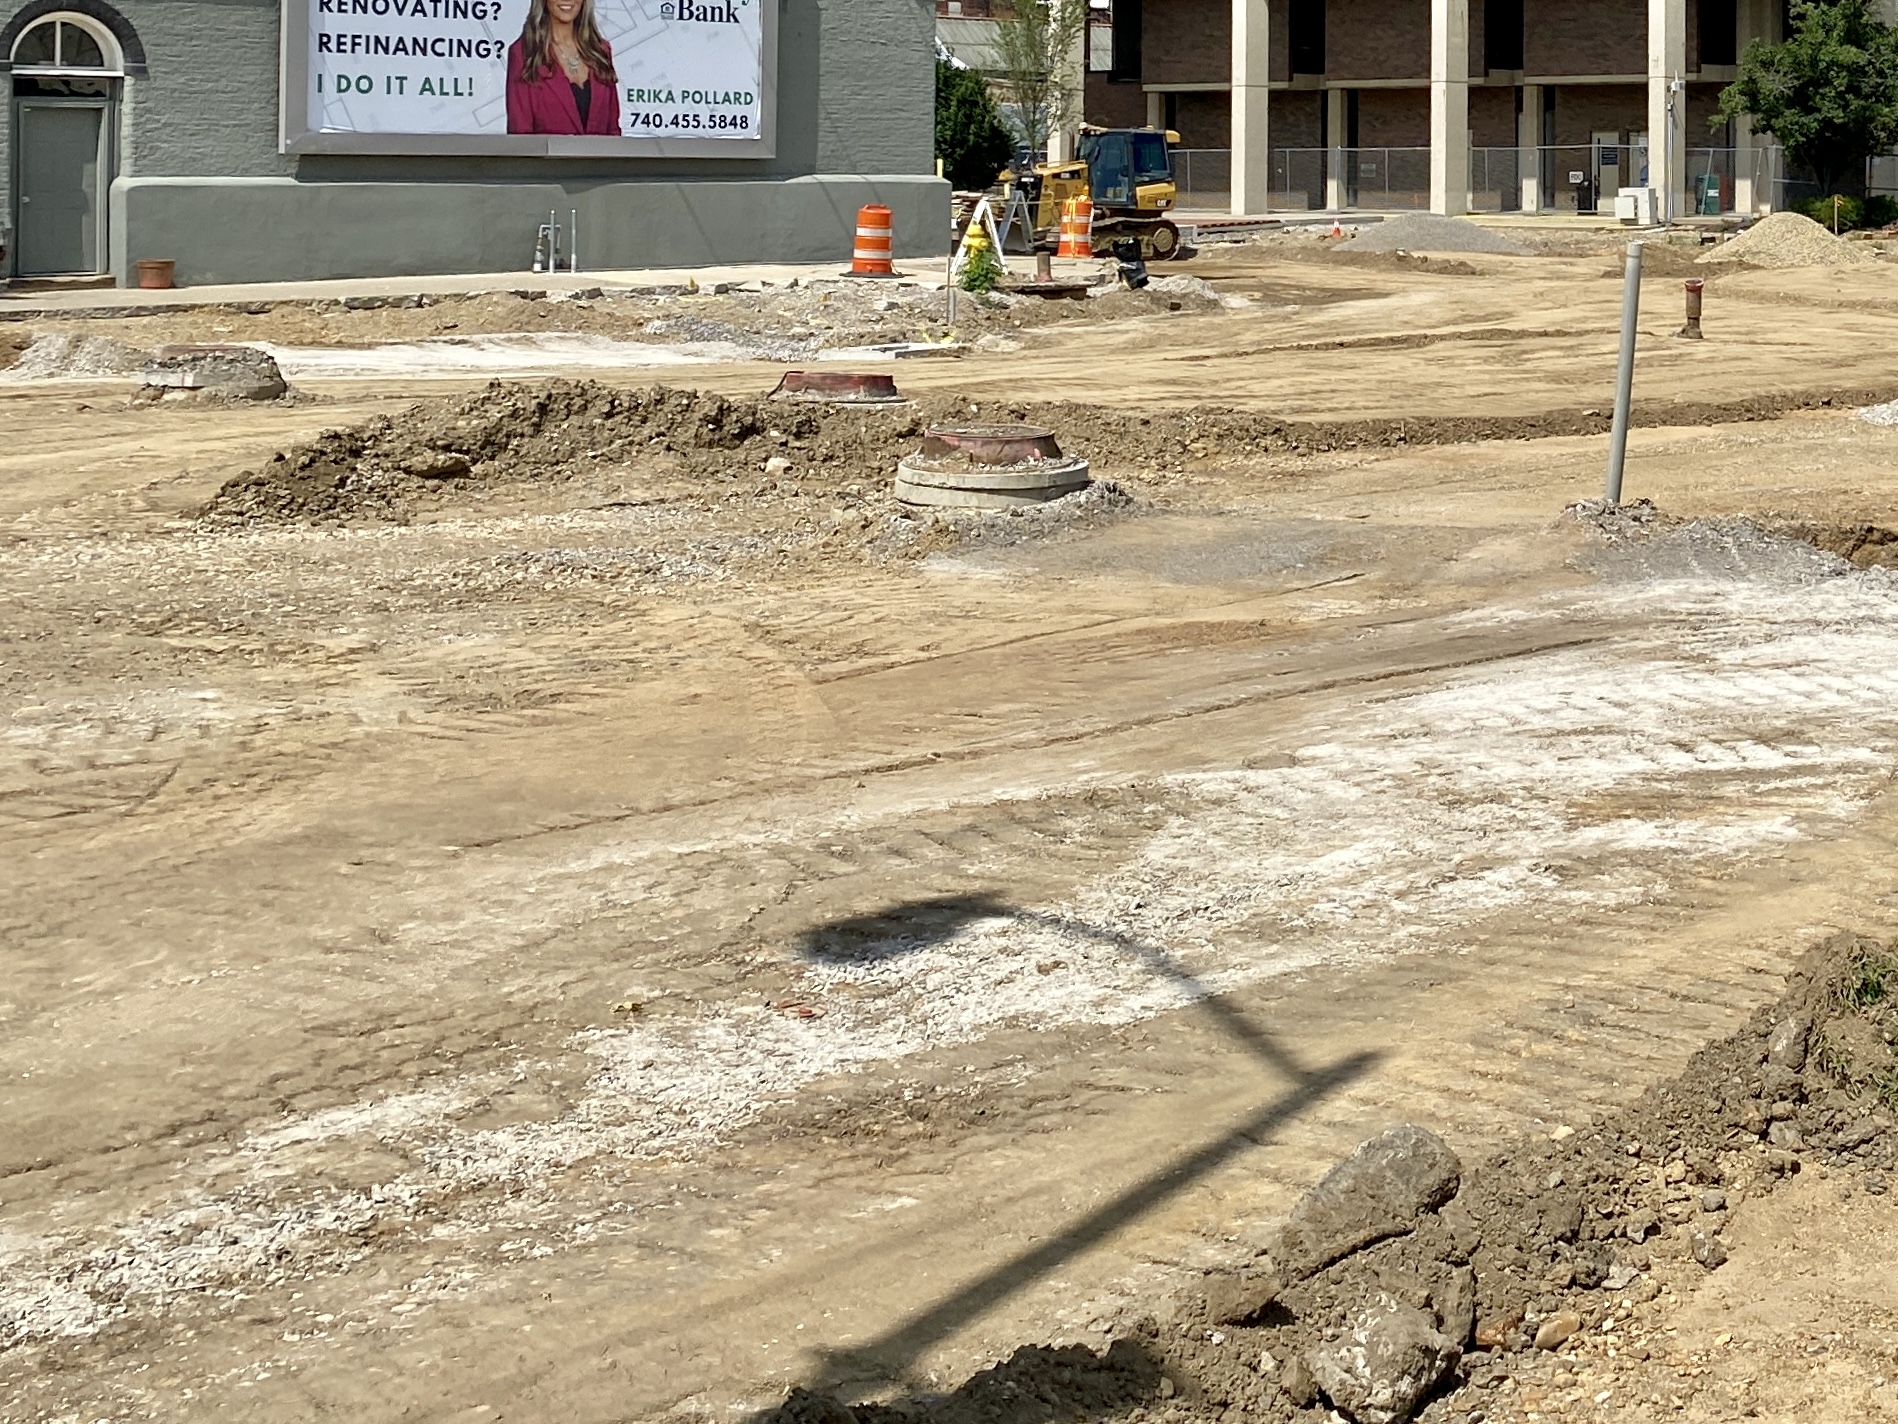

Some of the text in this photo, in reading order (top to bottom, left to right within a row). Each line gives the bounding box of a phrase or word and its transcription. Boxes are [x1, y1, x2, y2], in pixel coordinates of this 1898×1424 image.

[318, 33, 505, 59] REFINANCING?
[317, 73, 474, 97] I DO IT ALL!
[627, 88, 754, 106] ERIKA POLLARD
[630, 112, 749, 130] 740.455.5848
